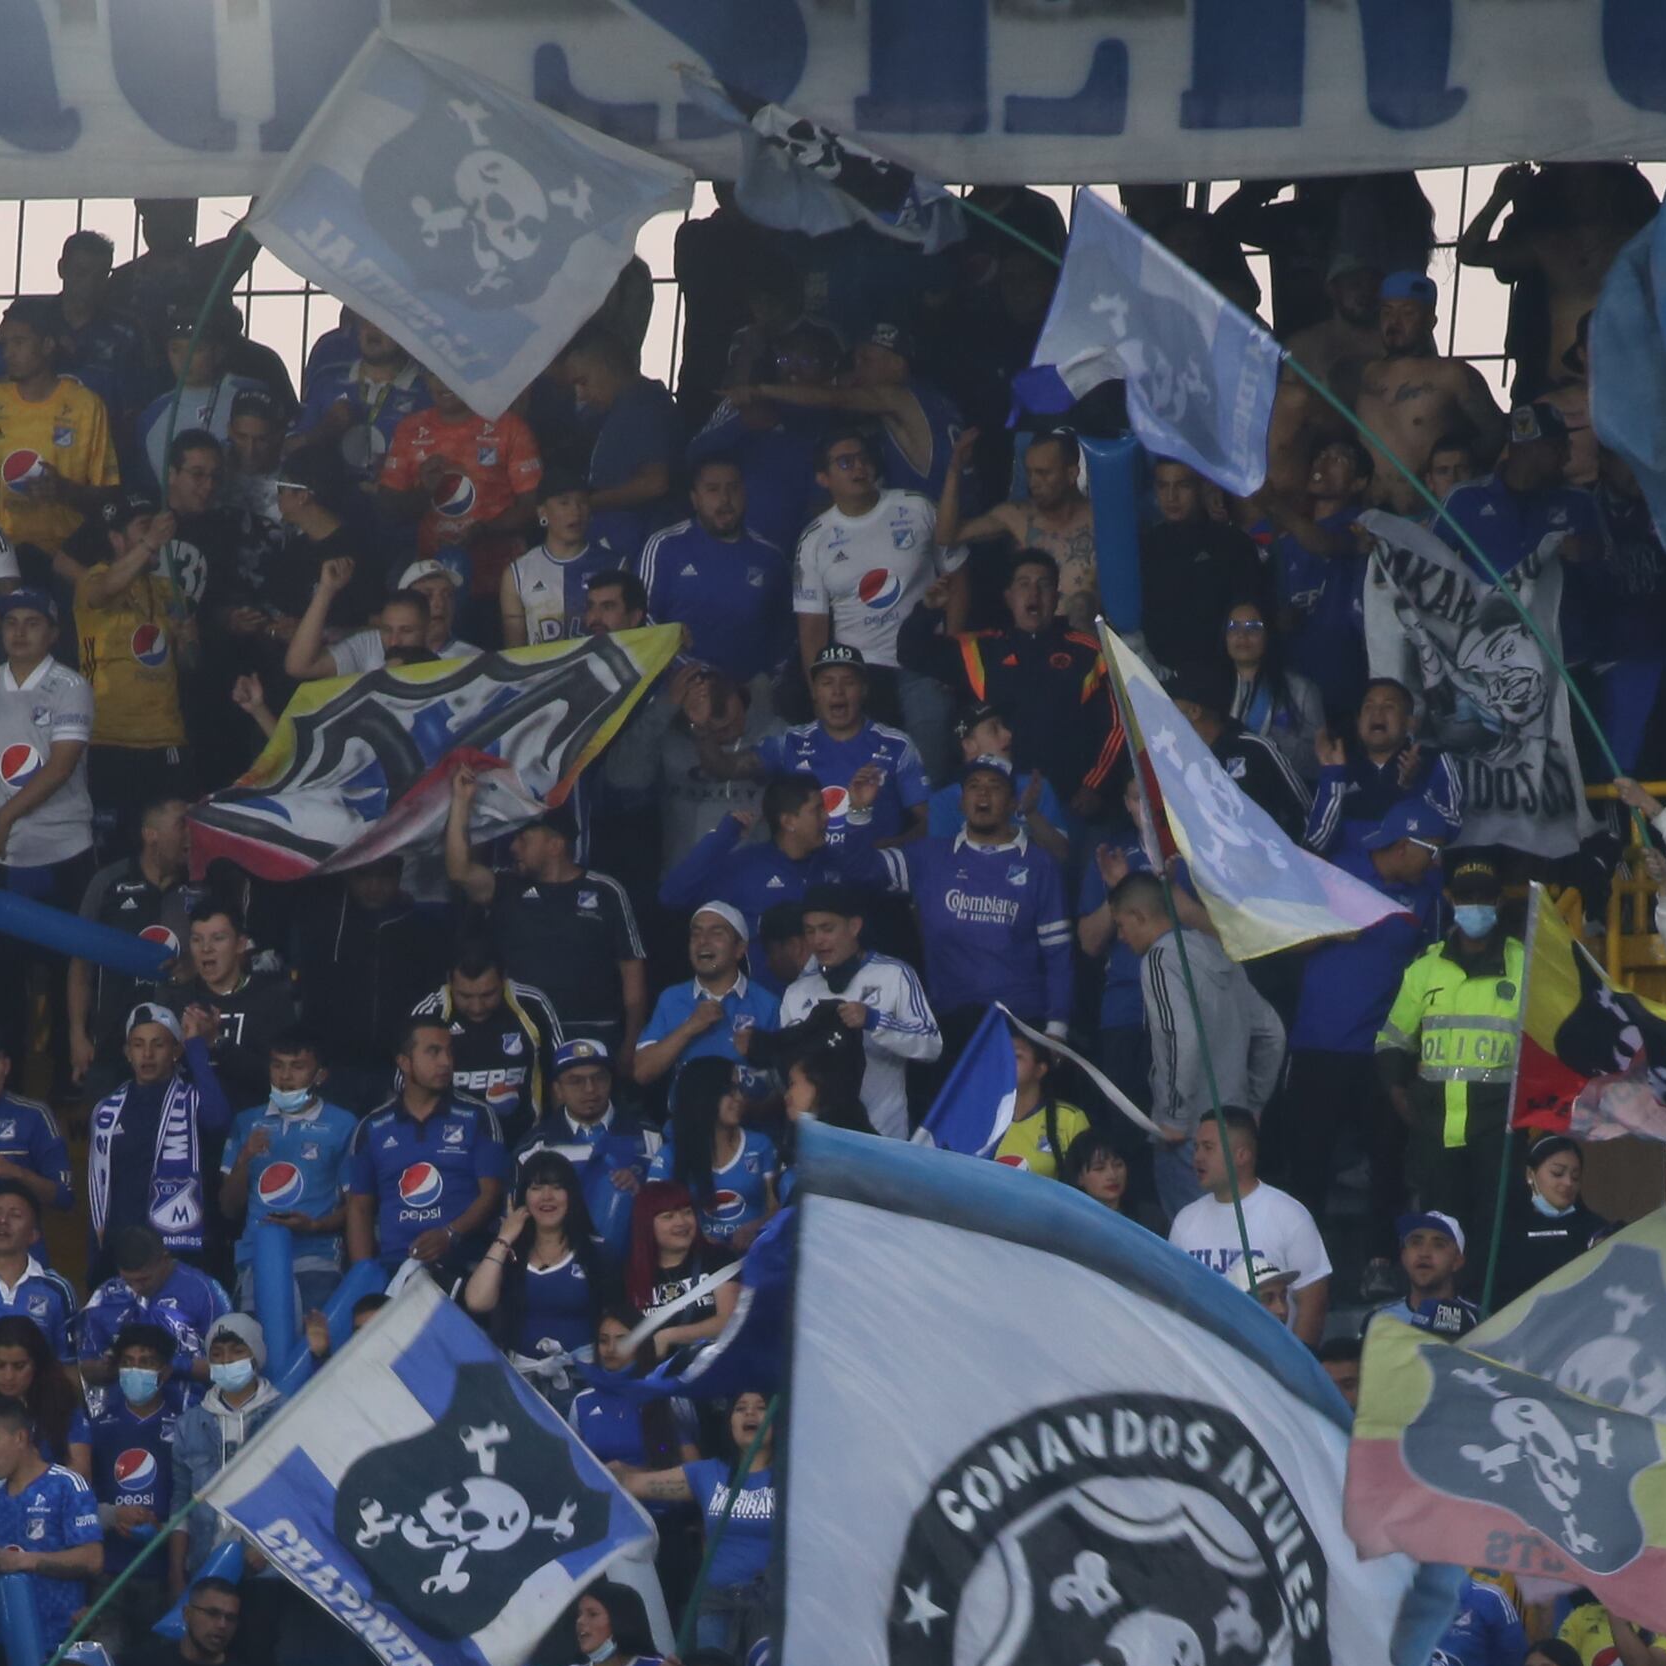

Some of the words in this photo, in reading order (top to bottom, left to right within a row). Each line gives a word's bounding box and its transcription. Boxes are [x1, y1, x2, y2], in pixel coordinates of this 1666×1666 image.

[399, 1205, 442, 1224] pepsi
[115, 1492, 156, 1508] pepsi
[936, 1407, 1218, 1533] COMANDOS
[1221, 1444, 1321, 1641] AZULES
